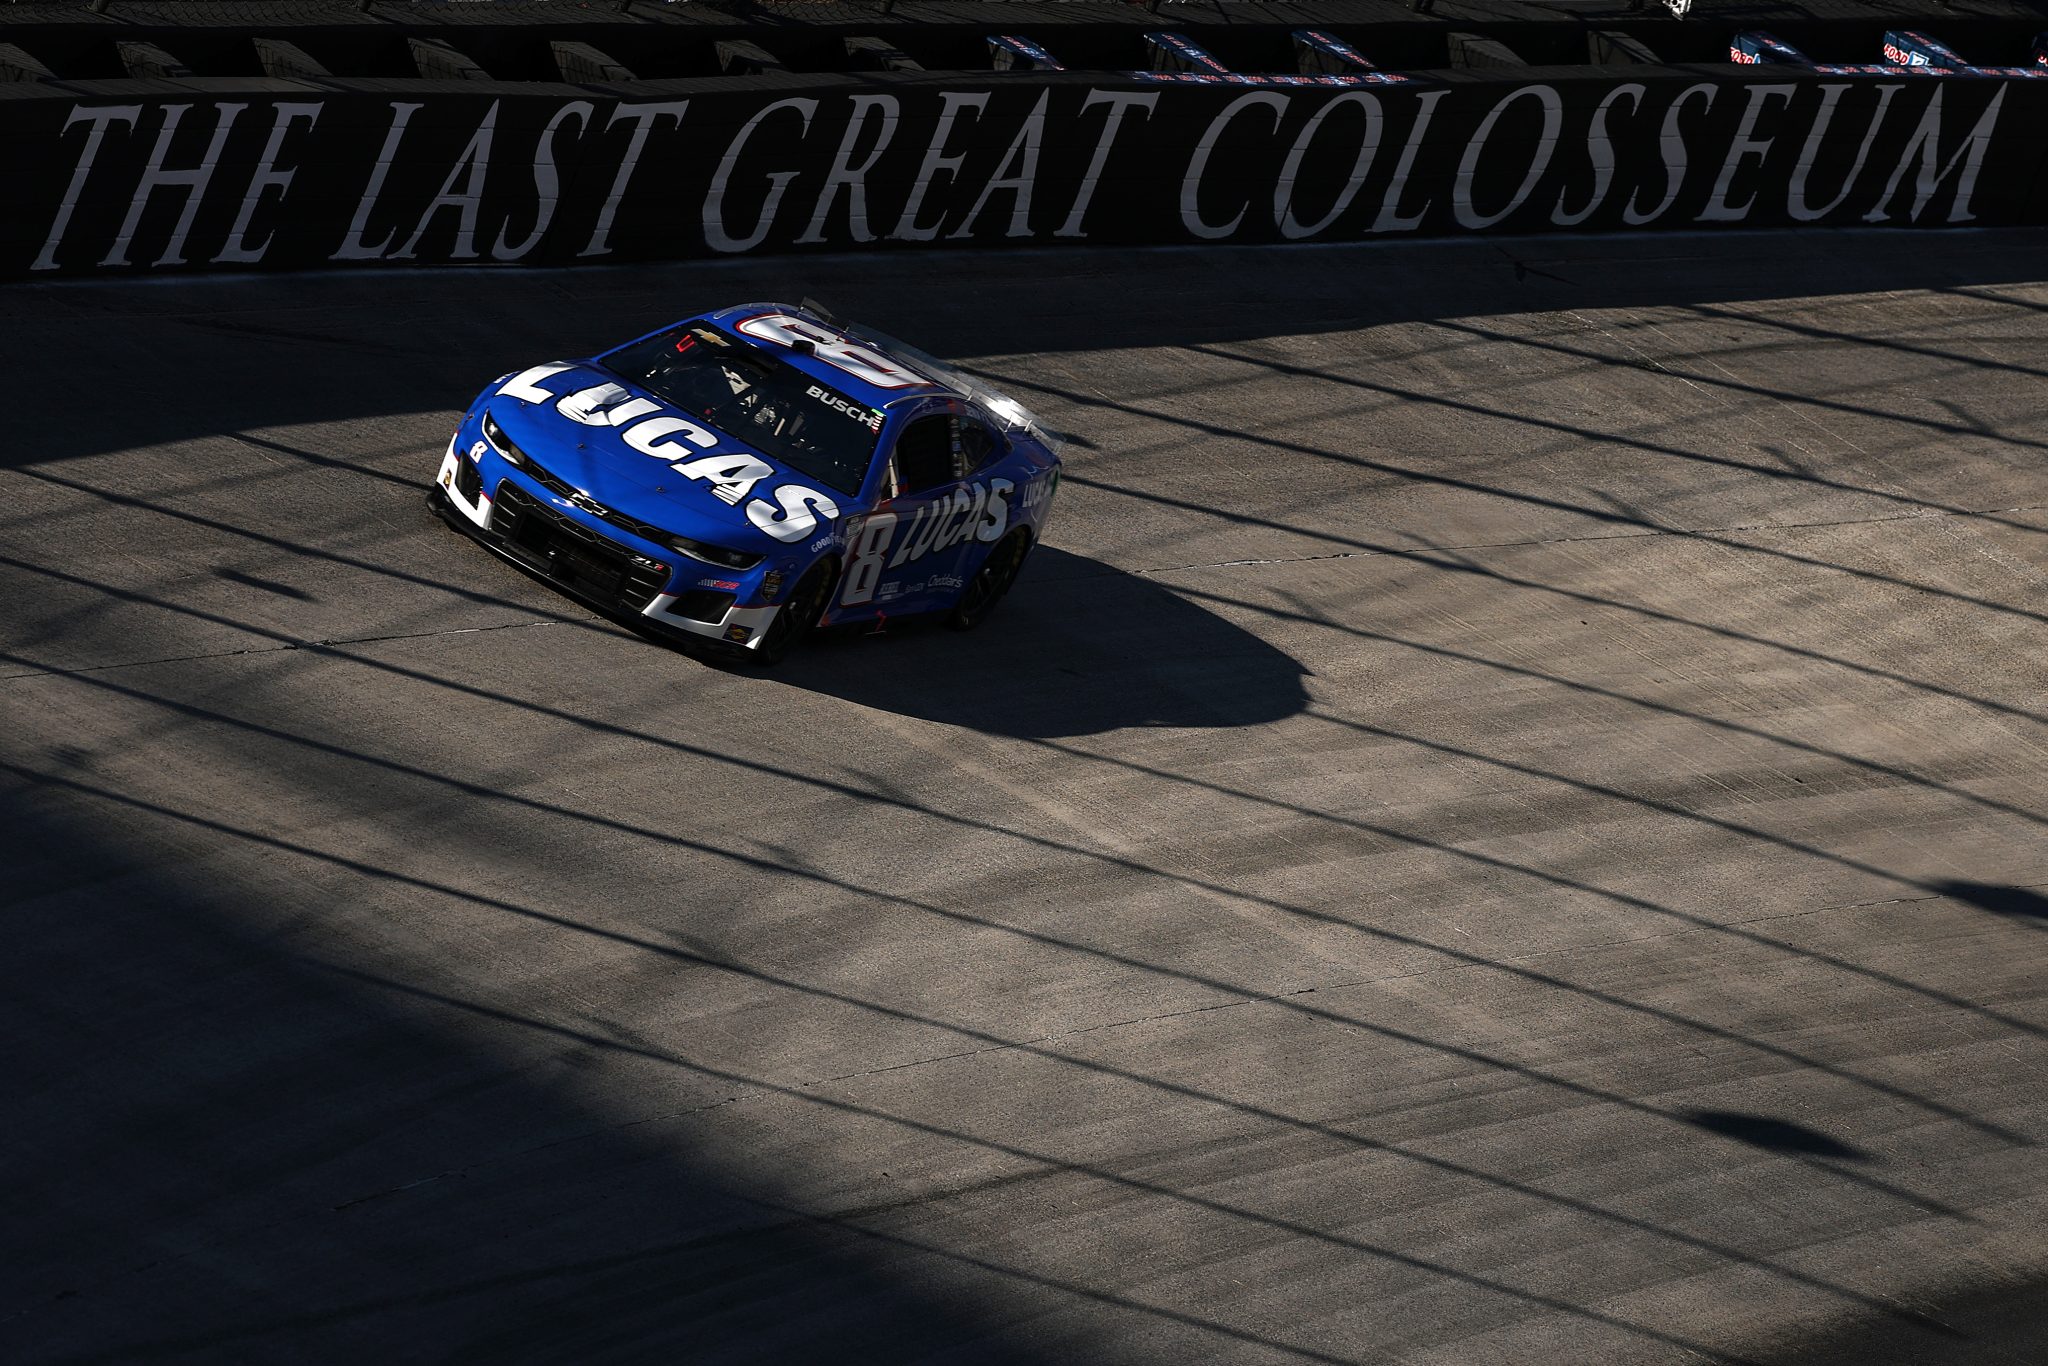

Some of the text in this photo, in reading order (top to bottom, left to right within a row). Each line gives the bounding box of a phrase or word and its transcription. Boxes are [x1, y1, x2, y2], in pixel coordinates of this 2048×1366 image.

[29, 82, 2008, 271] THE LAST GREAT COLOSSEUM
[469, 440, 489, 464] 8
[494, 360, 840, 544] LUCAS
[806, 384, 874, 428] BUSCH
[840, 512, 898, 608] 8
[887, 477, 1015, 569] LUCAS
